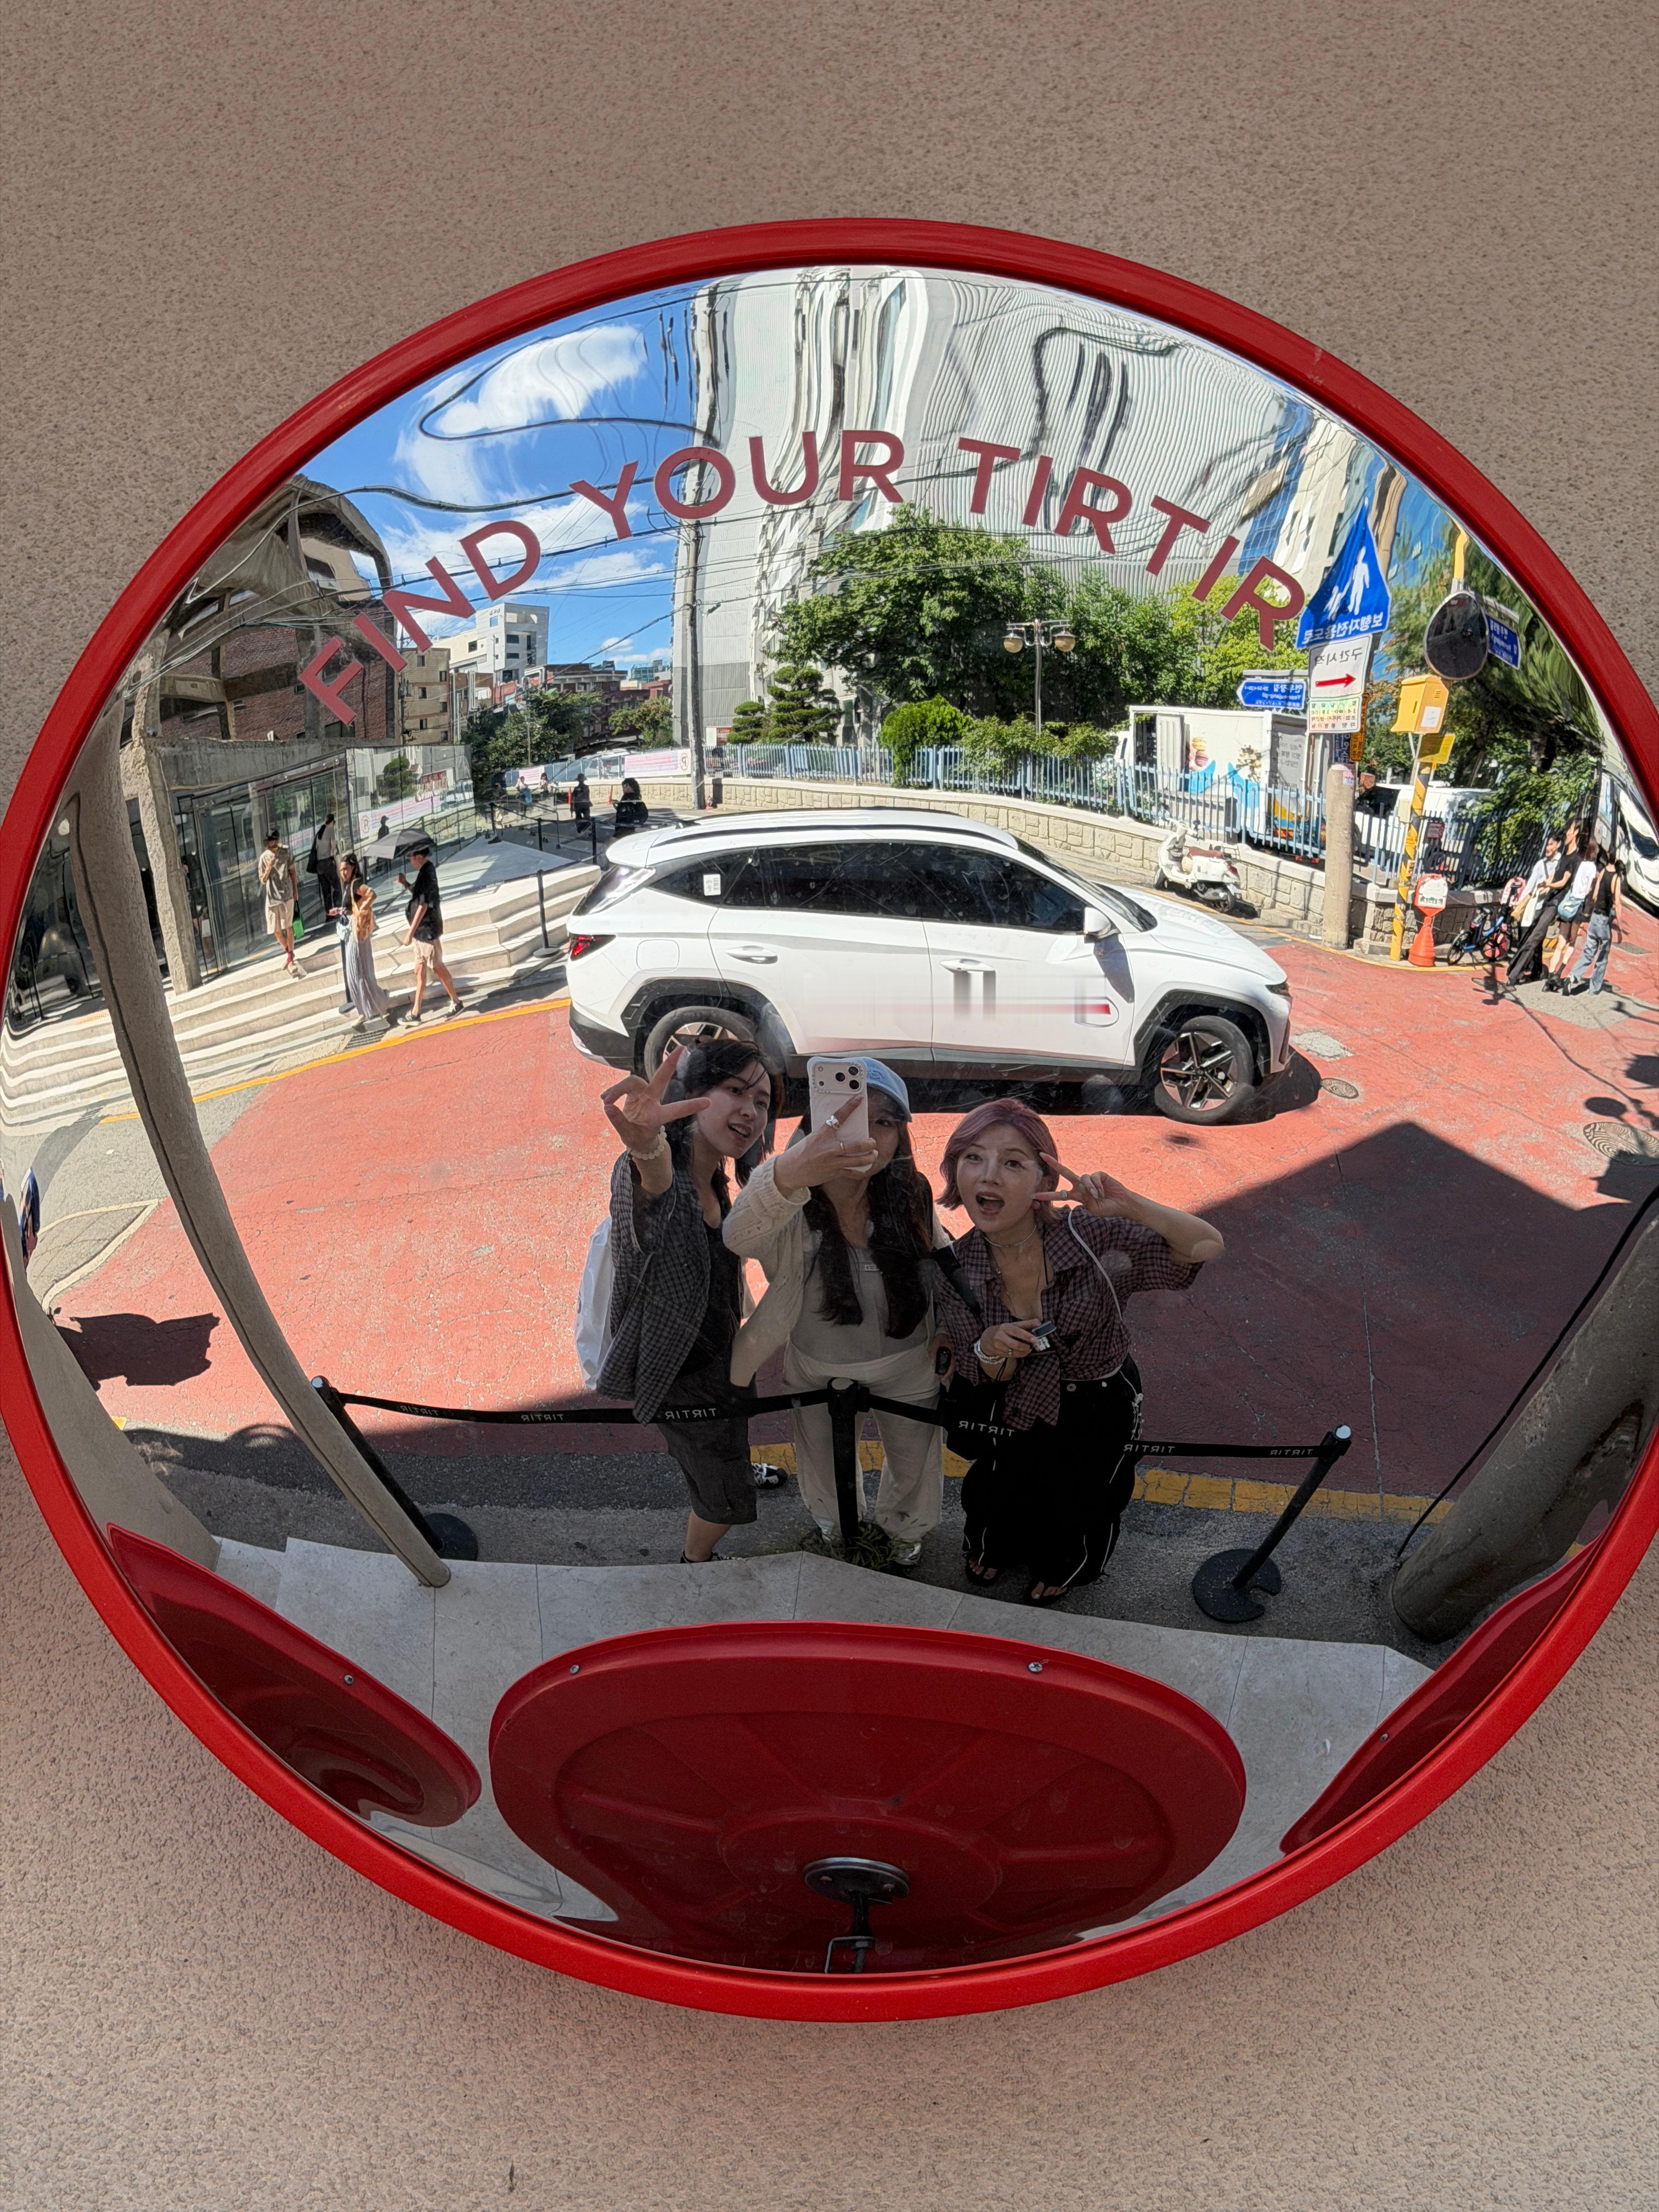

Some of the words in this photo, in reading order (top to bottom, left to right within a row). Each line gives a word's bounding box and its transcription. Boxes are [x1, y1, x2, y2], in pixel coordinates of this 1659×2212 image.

[299, 521, 541, 724] FIND
[569, 430, 904, 539] YOUR
[958, 437, 1305, 651] TIRTIR
